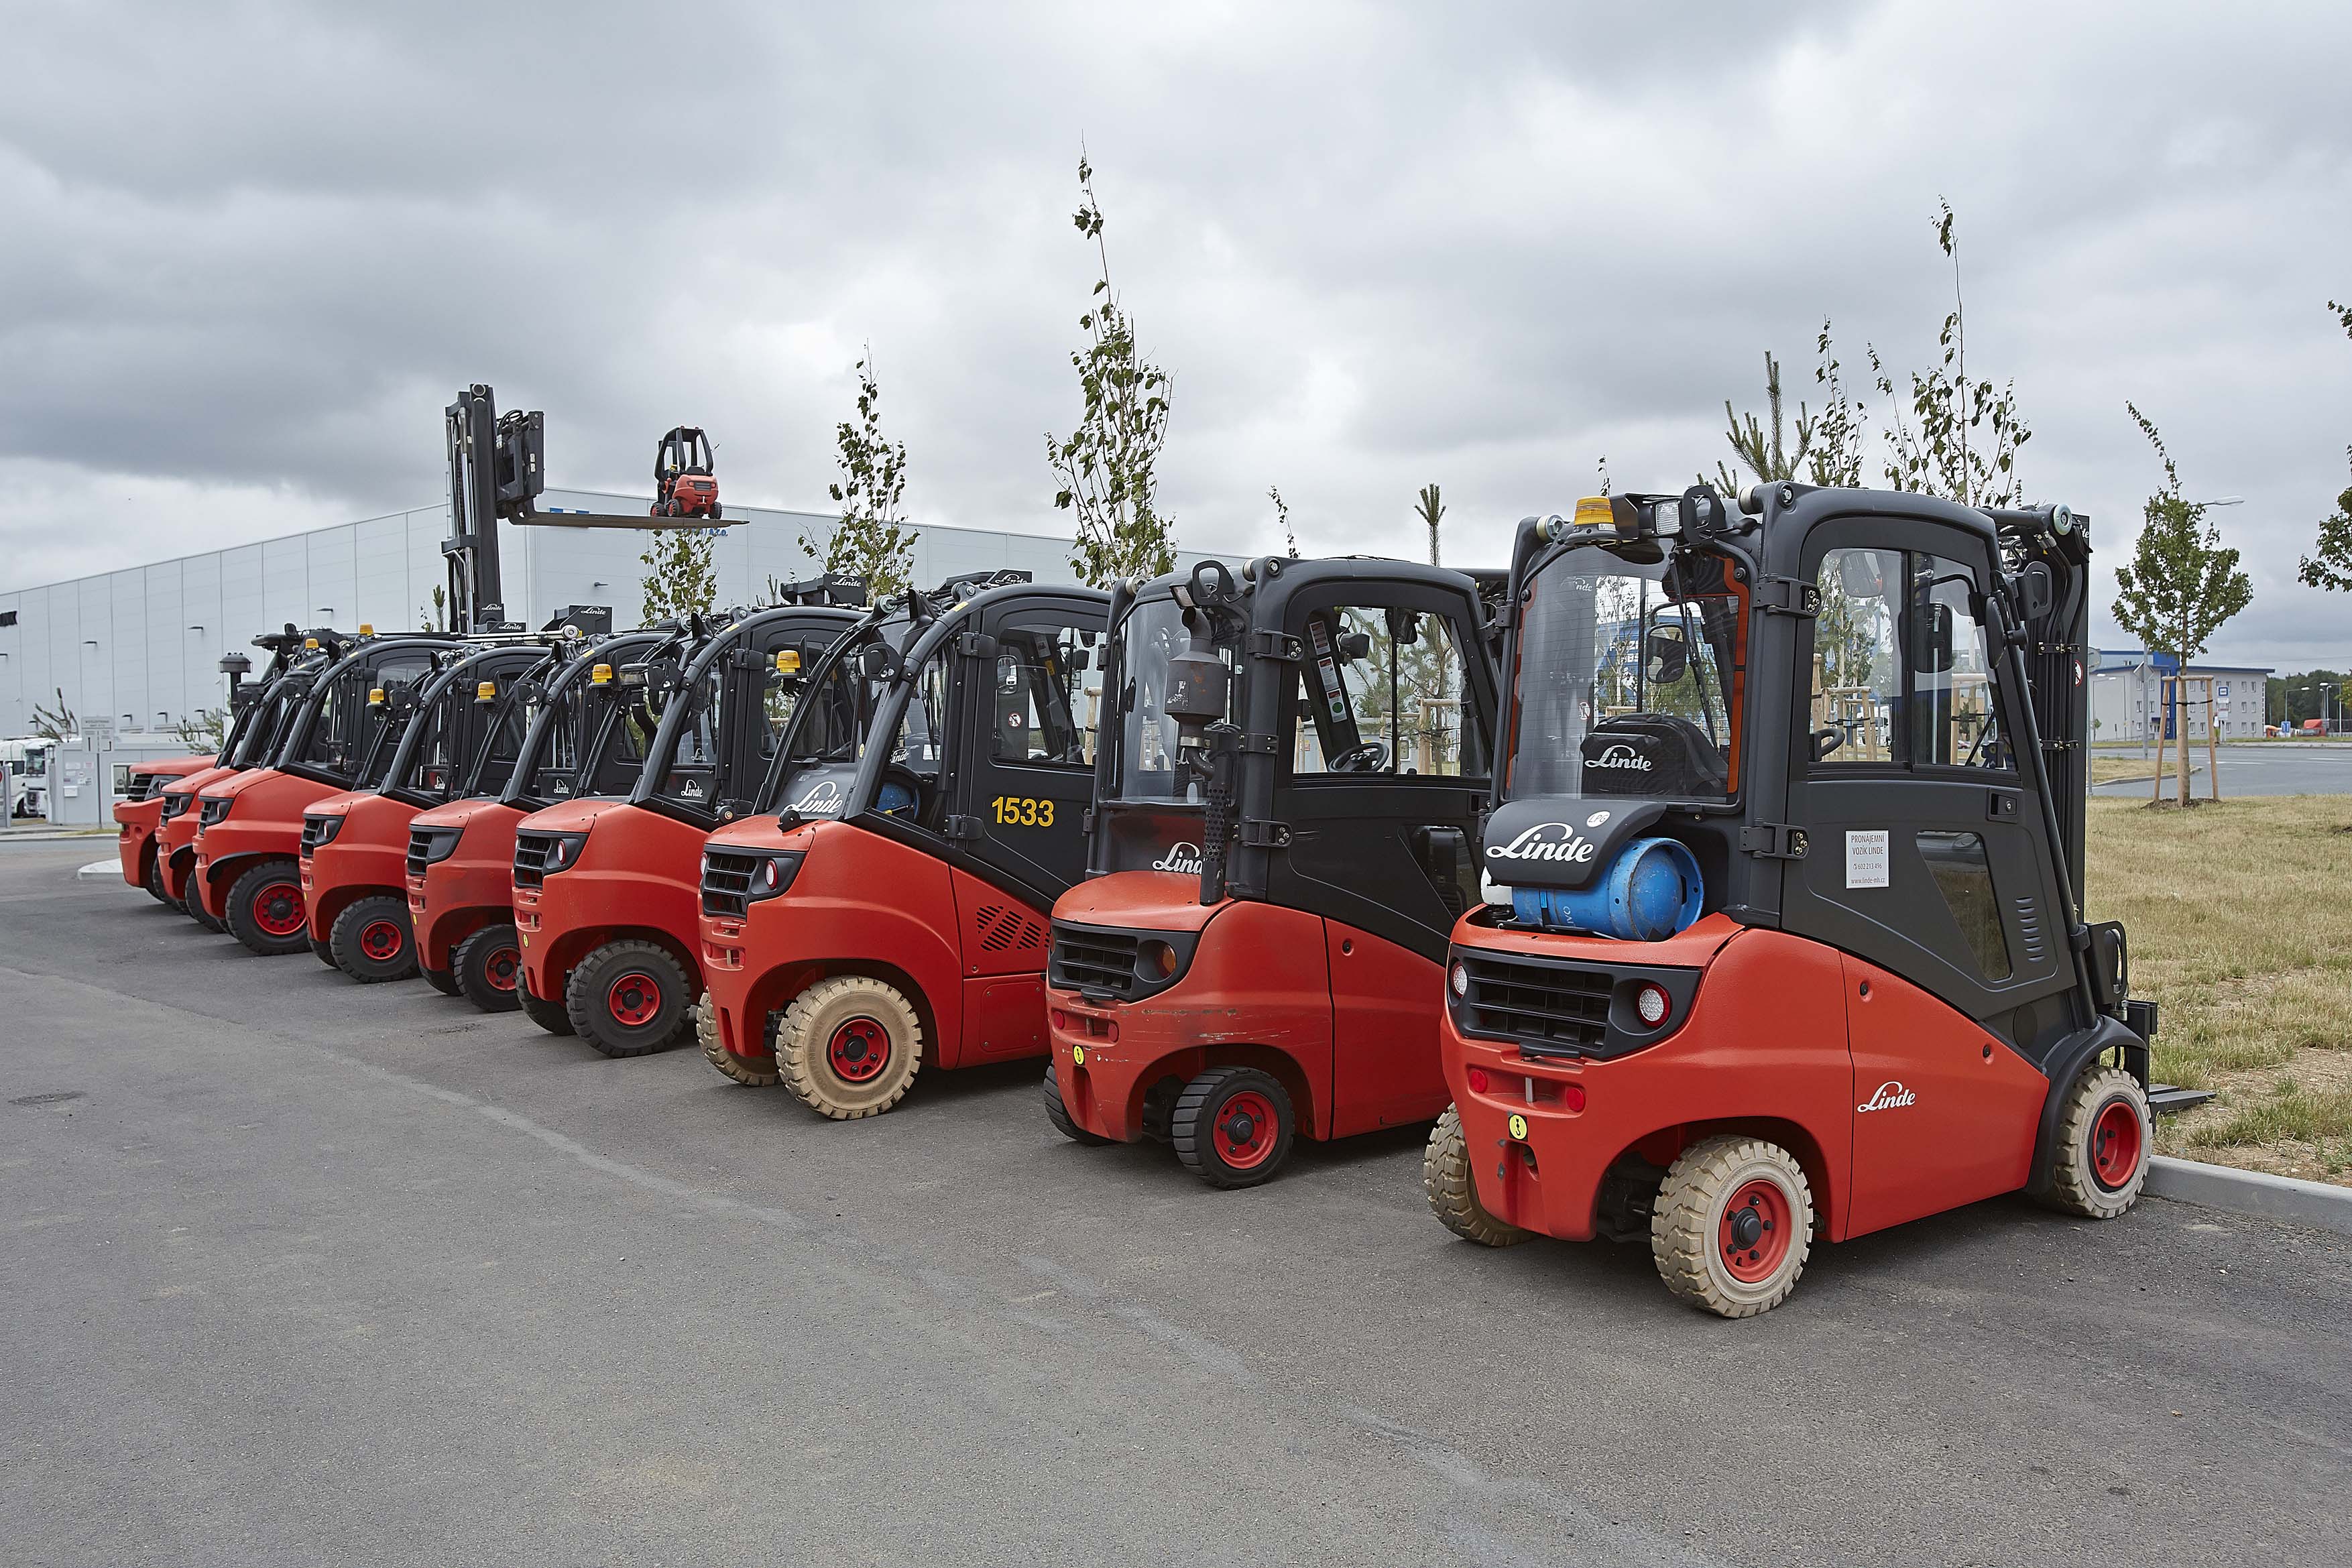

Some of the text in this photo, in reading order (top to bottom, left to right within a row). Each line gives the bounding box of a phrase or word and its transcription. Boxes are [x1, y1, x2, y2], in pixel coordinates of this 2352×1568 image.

[831, 576, 862, 587] Linde
[581, 606, 606, 615] Linde
[498, 622, 522, 630] Linde
[1584, 745, 1653, 772] Linde
[553, 779, 569, 794] Linde
[681, 779, 703, 798] Linde
[784, 781, 843, 814] Linde
[992, 796, 1054, 827] 1533
[1588, 814, 1608, 823] LPG
[1486, 822, 1594, 863] Linde
[1852, 845, 1883, 855] VOZÍK LINDE
[1857, 1081, 1916, 1113] Linde
